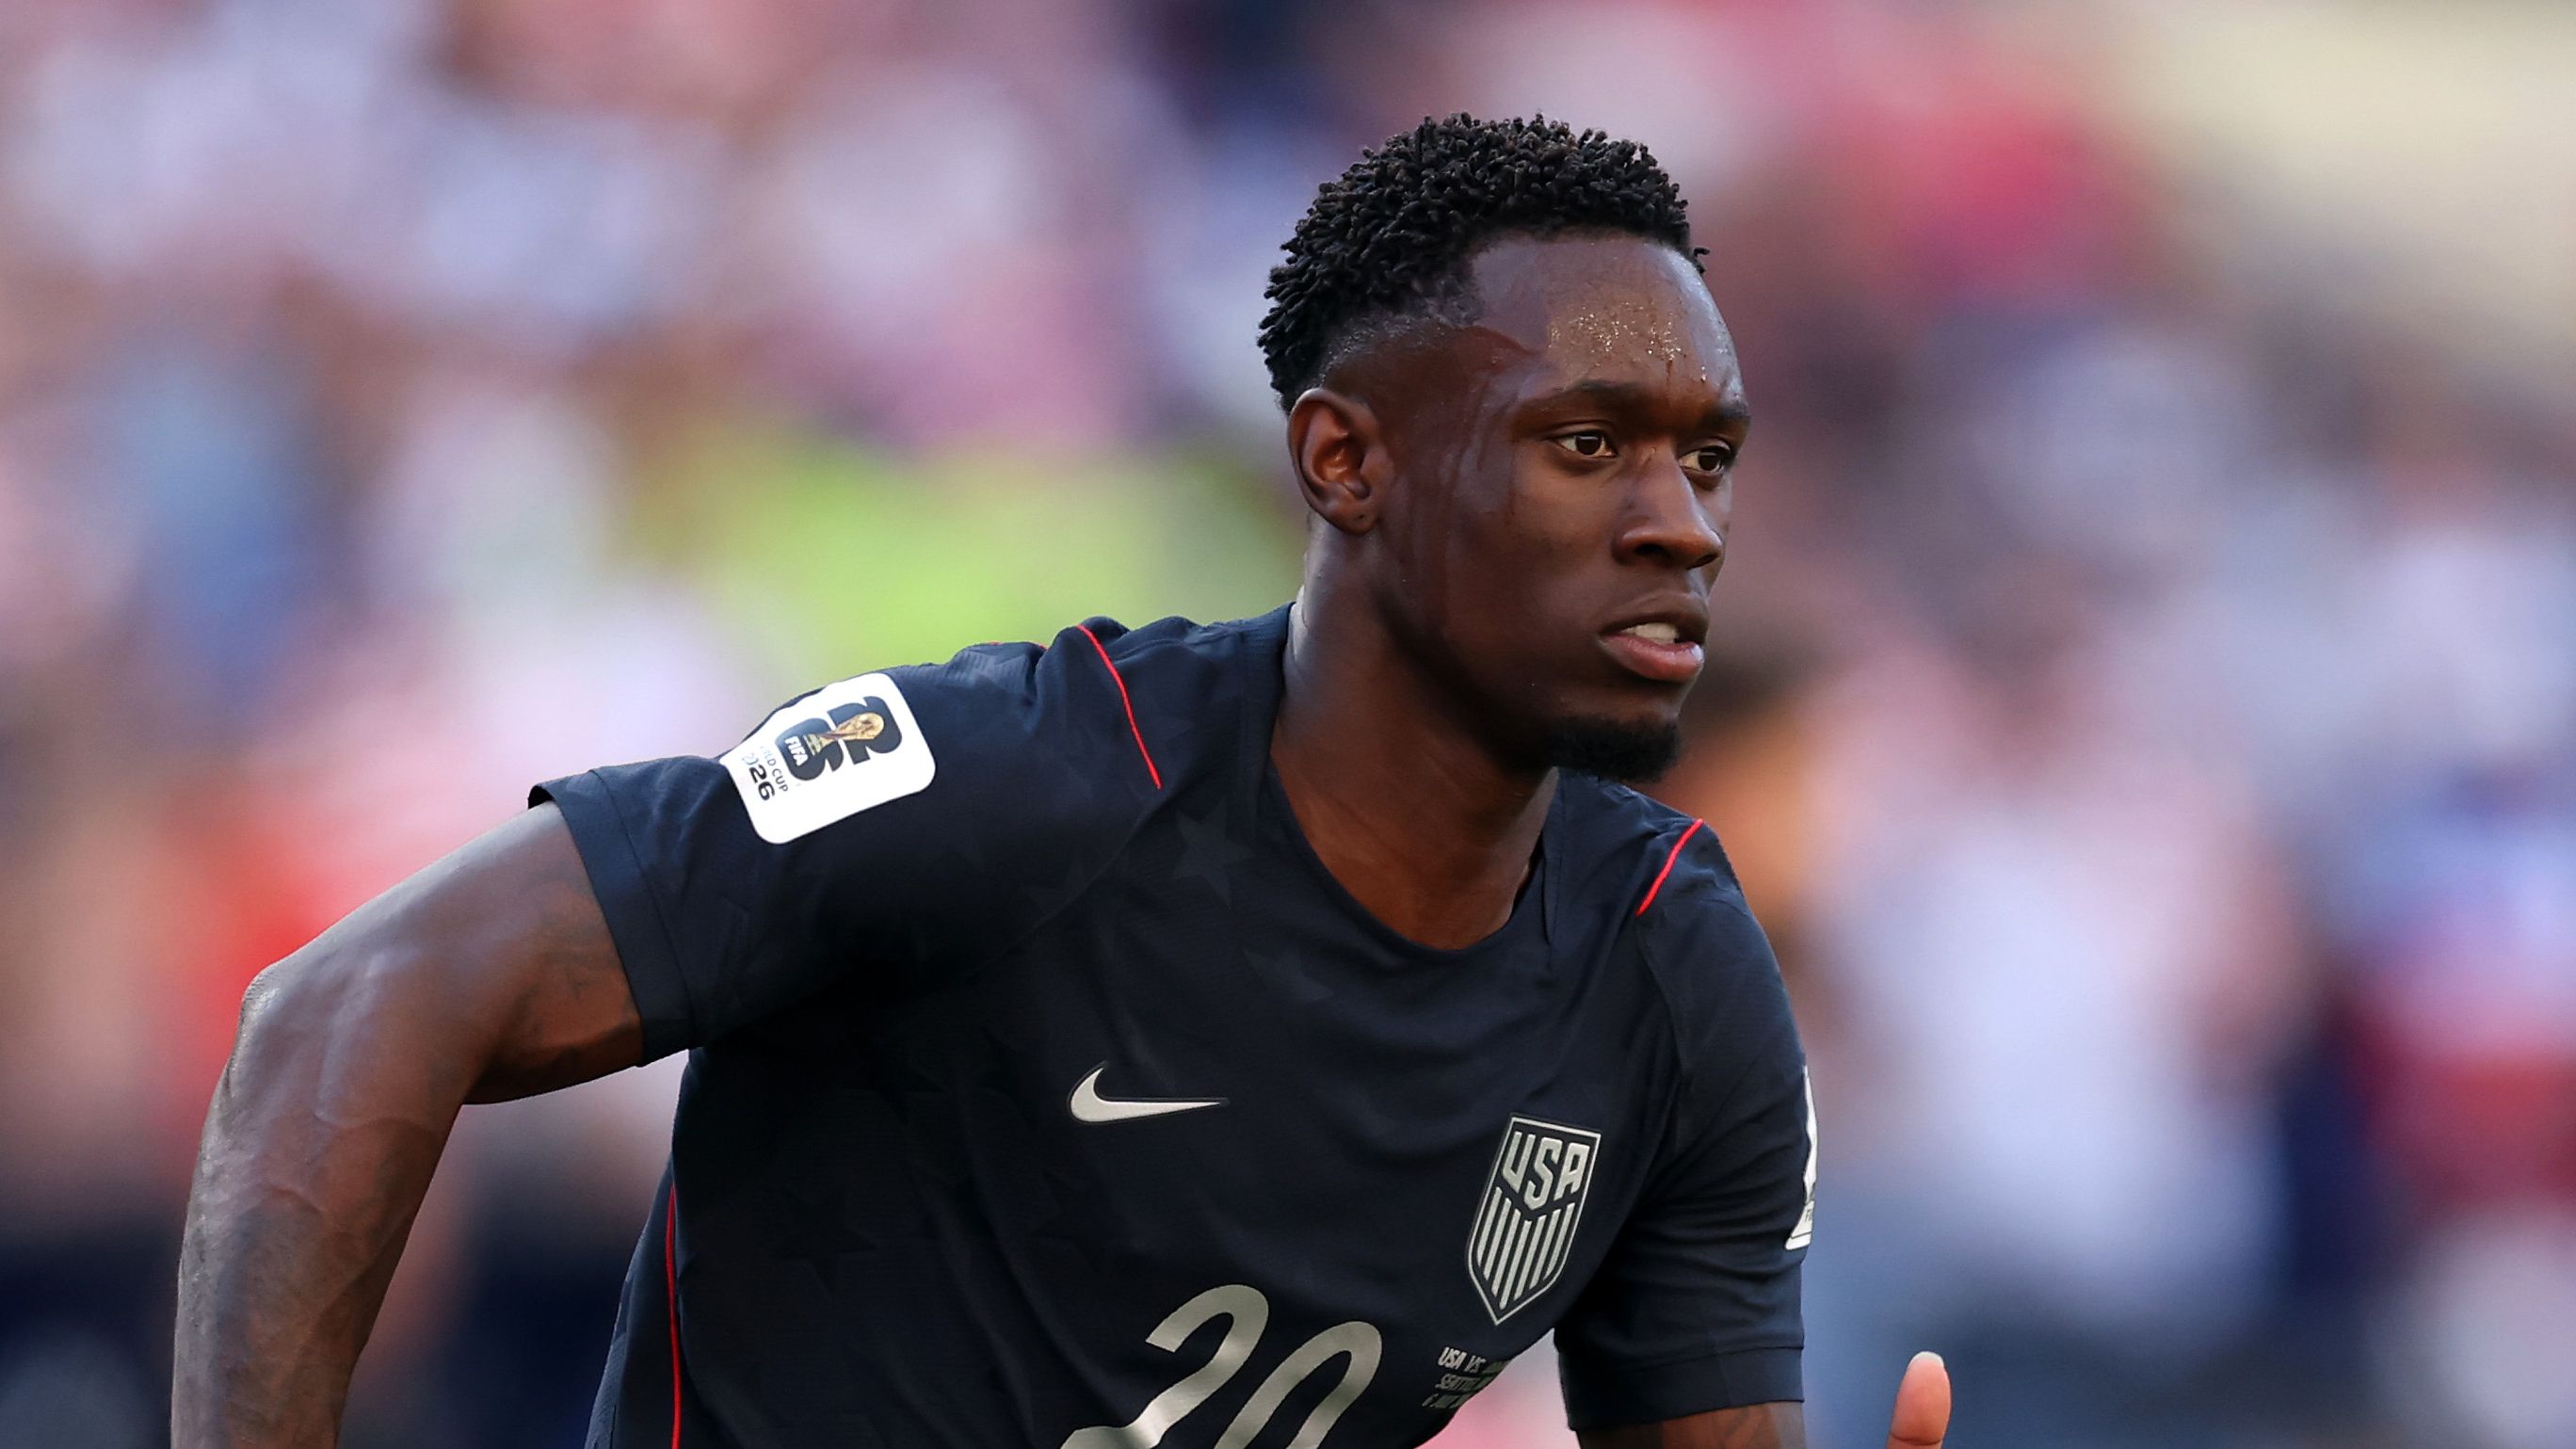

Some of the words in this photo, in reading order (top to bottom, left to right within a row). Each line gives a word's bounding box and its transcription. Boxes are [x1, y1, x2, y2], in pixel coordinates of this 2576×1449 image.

[785, 735, 809, 767] FIFA
[771, 767, 789, 792] CUP
[1502, 1131, 1590, 1211] USA
[1061, 1283, 1382, 1449] 20
[1438, 1346, 1467, 1370] USA
